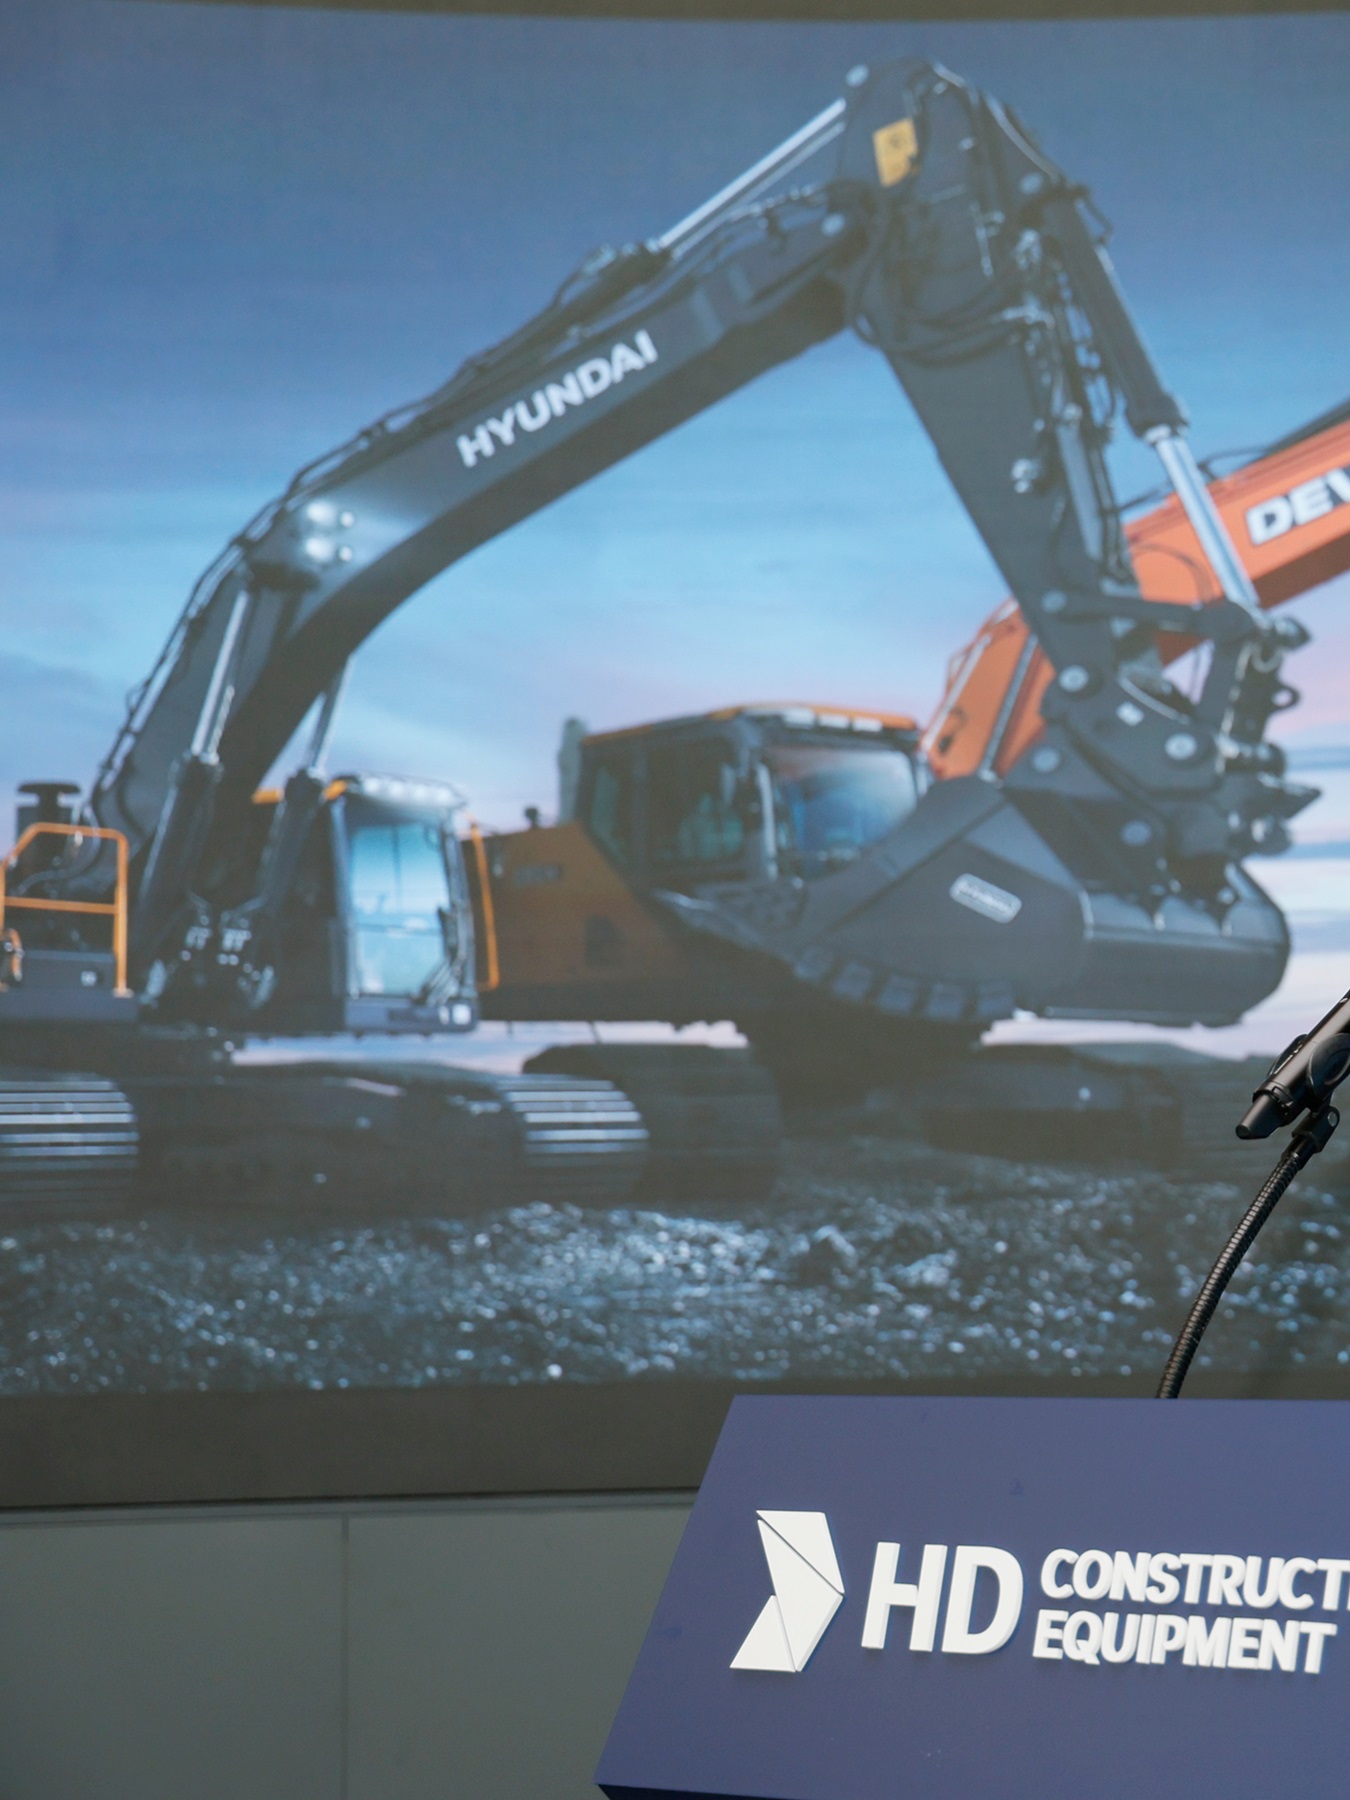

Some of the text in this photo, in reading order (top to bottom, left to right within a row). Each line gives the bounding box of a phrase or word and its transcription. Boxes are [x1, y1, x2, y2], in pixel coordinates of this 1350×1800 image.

[456, 329, 659, 468] HYUNDAI
[860, 1541, 1024, 1655] HD
[1032, 1609, 1338, 1675] EQUIPMENT
